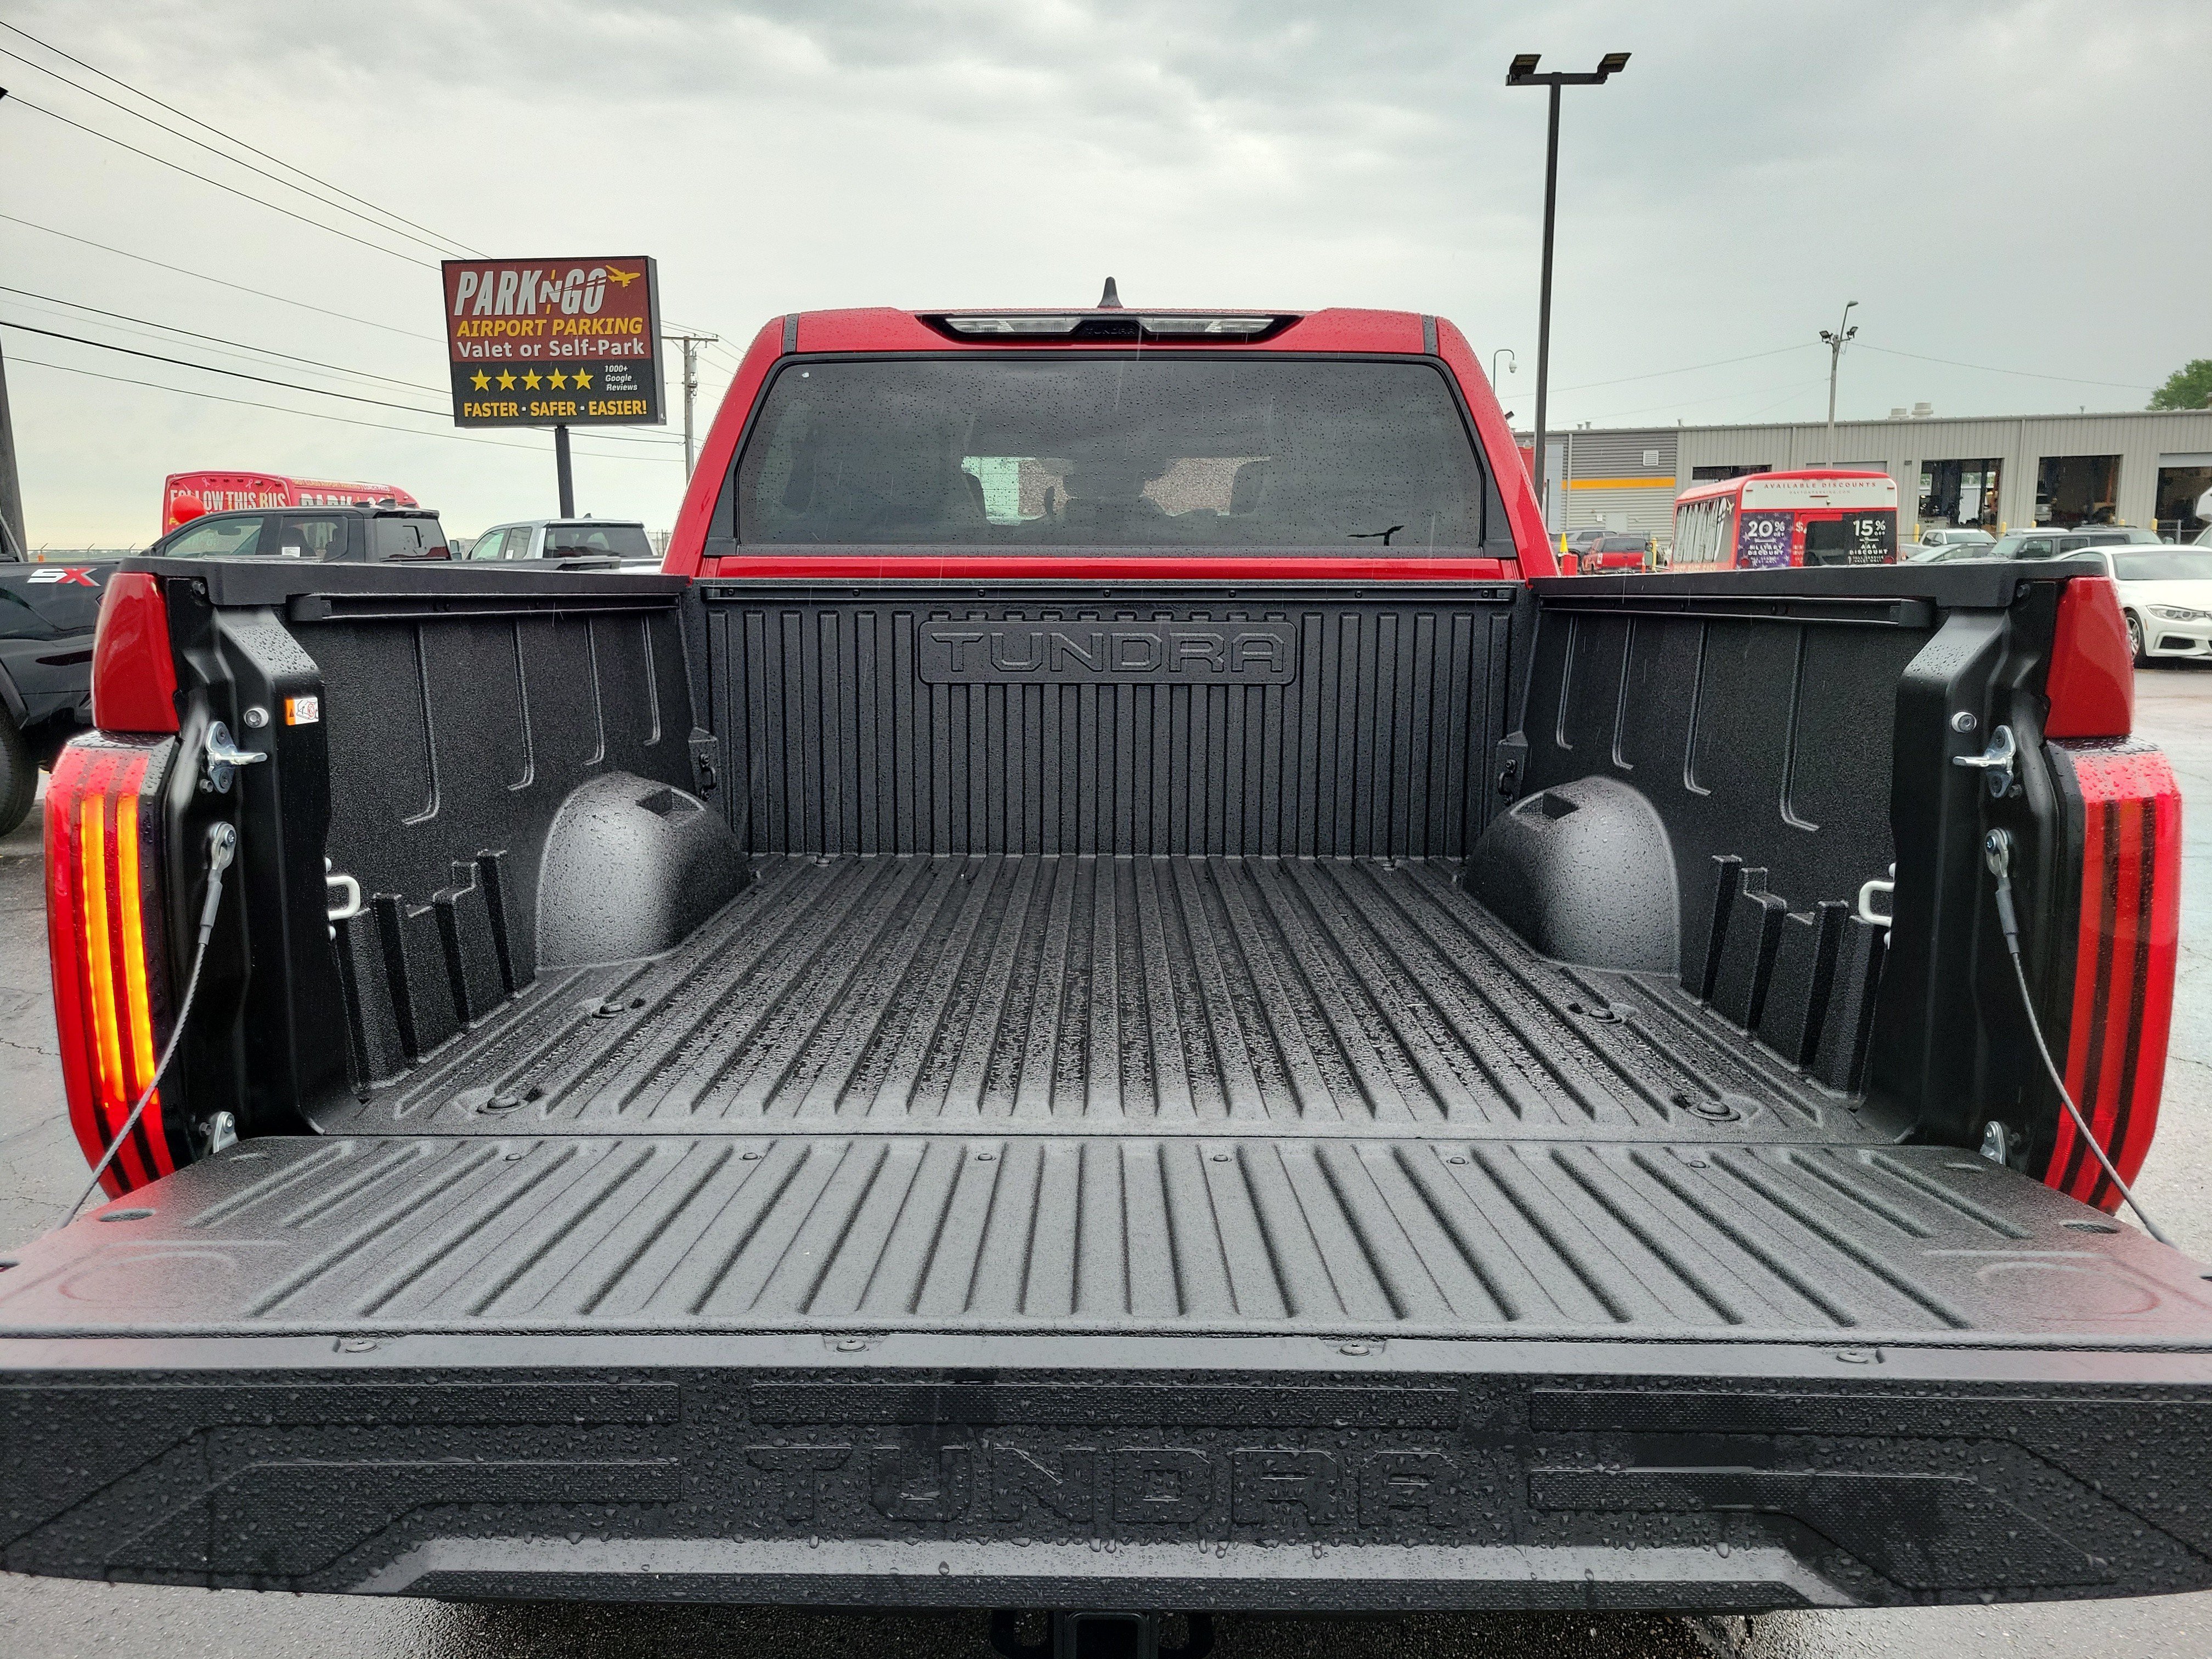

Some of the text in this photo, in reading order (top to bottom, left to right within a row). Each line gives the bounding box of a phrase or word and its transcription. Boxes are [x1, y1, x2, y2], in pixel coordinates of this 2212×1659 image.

[454, 270, 543, 316] PARK
[561, 268, 607, 314] GO
[456, 317, 643, 337] AIRPORT PARKING
[457, 338, 645, 358] Valet or Self-Park
[605, 374, 632, 383] Google
[464, 399, 647, 417] FASTER SAFER EASIER!
[225, 492, 257, 511] THIS
[259, 493, 286, 508] BUS
[27, 568, 101, 587] SX
[931, 632, 1284, 672] TUNDRA
[744, 1446, 1462, 1527] TUNDRA
